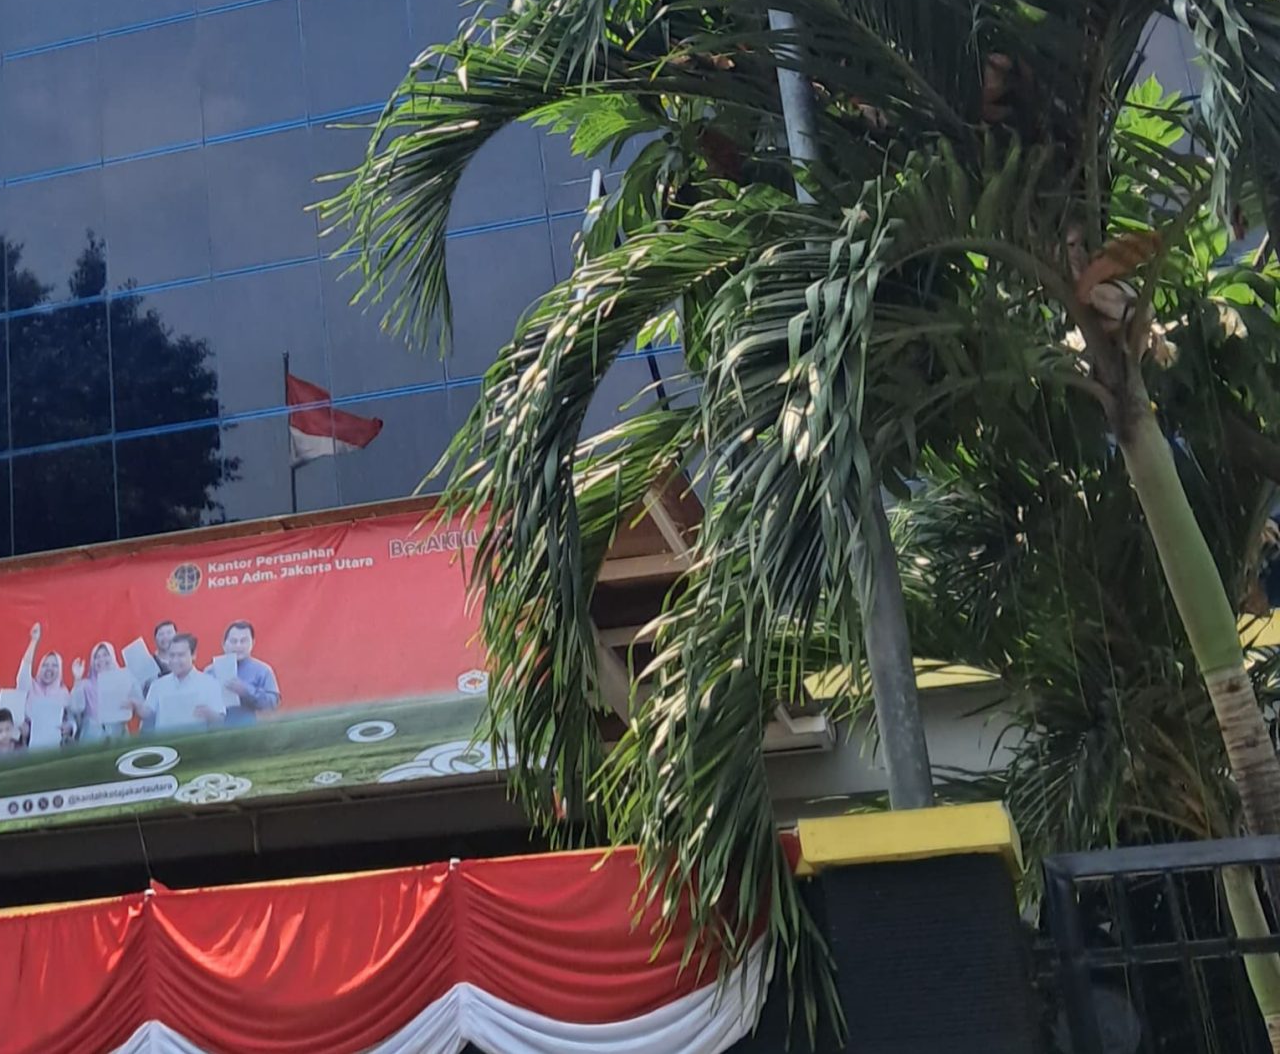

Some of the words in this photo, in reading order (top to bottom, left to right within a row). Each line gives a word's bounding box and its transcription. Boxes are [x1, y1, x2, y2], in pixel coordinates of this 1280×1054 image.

[208, 557, 252, 574] Kantor
[256, 546, 335, 567] Pertanahan
[208, 574, 239, 589] Kota
[242, 570, 278, 584] Adm.
[280, 561, 332, 578] Jakarta
[335, 555, 374, 569] Utara
